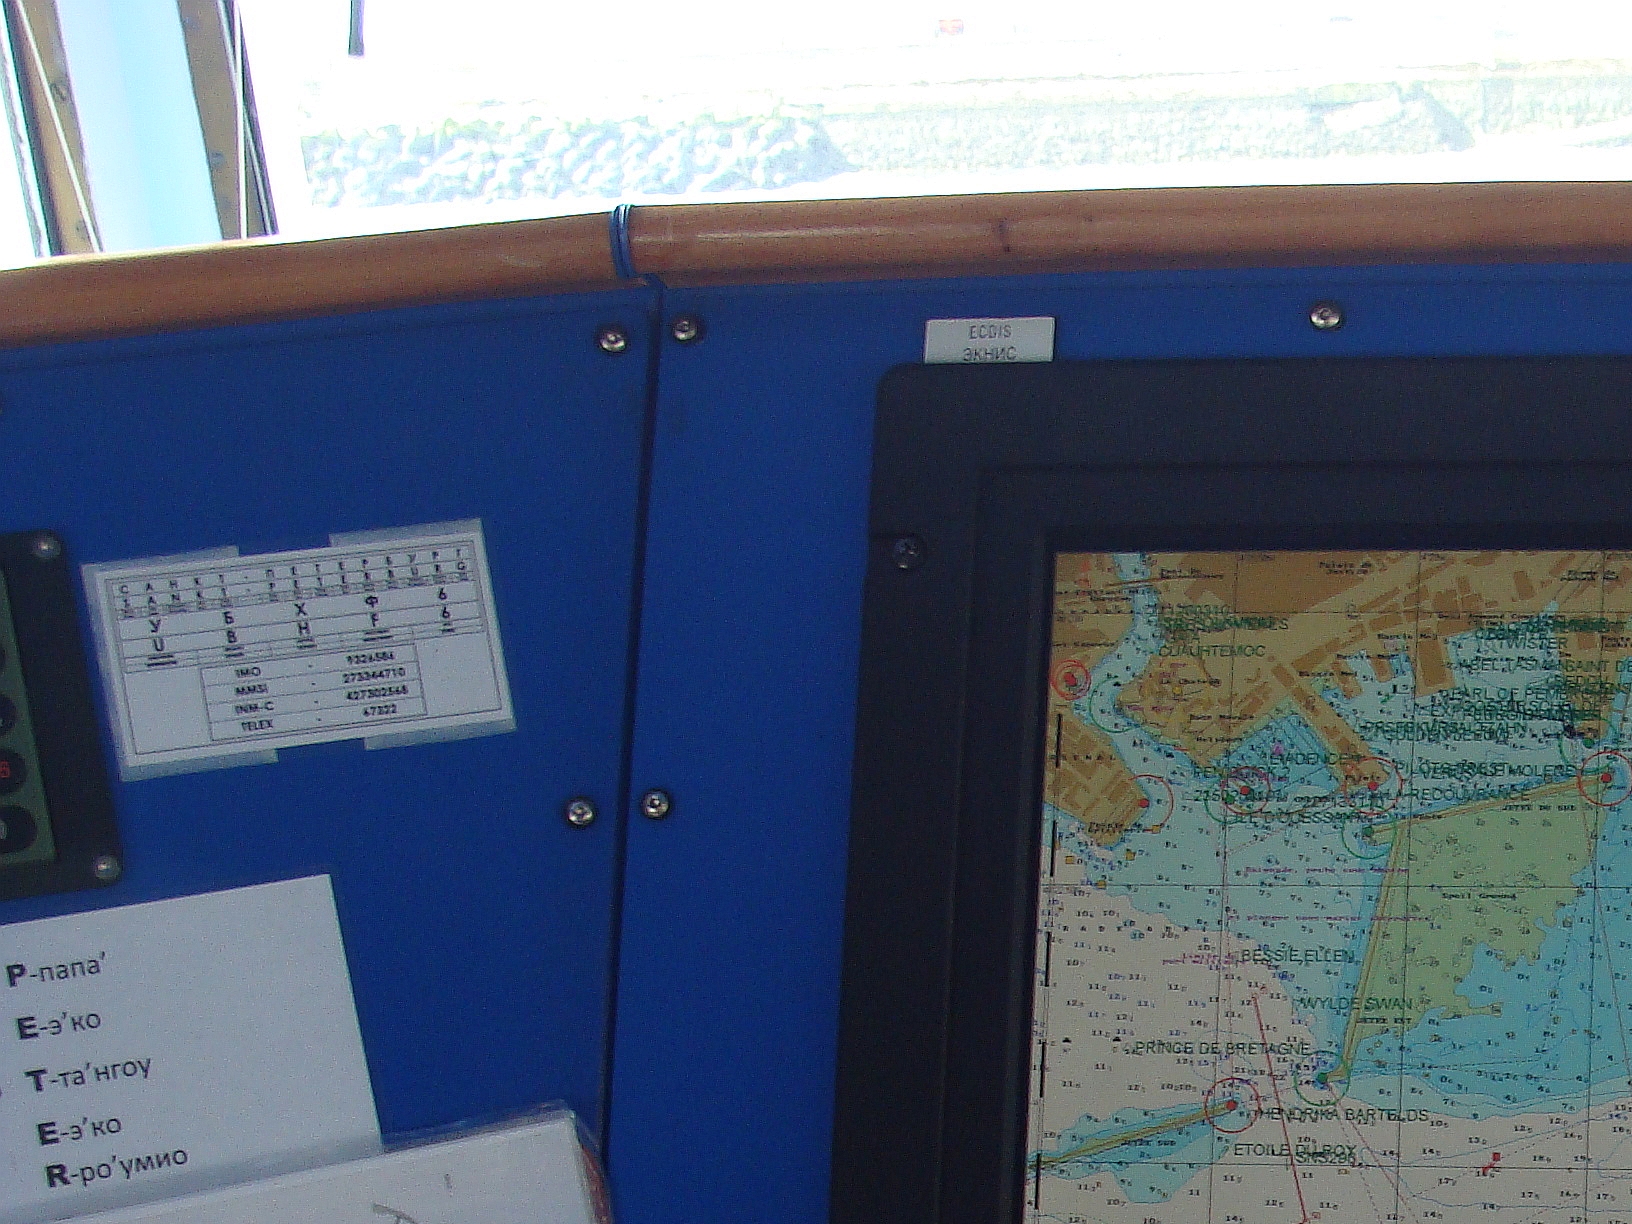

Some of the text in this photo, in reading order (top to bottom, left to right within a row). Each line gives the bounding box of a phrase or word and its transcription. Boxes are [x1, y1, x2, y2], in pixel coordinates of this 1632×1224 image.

[970, 325, 1011, 339] ECDIS
[963, 346, 1016, 361] ЭКНИС
[1200, 1041, 1219, 1055] DE
